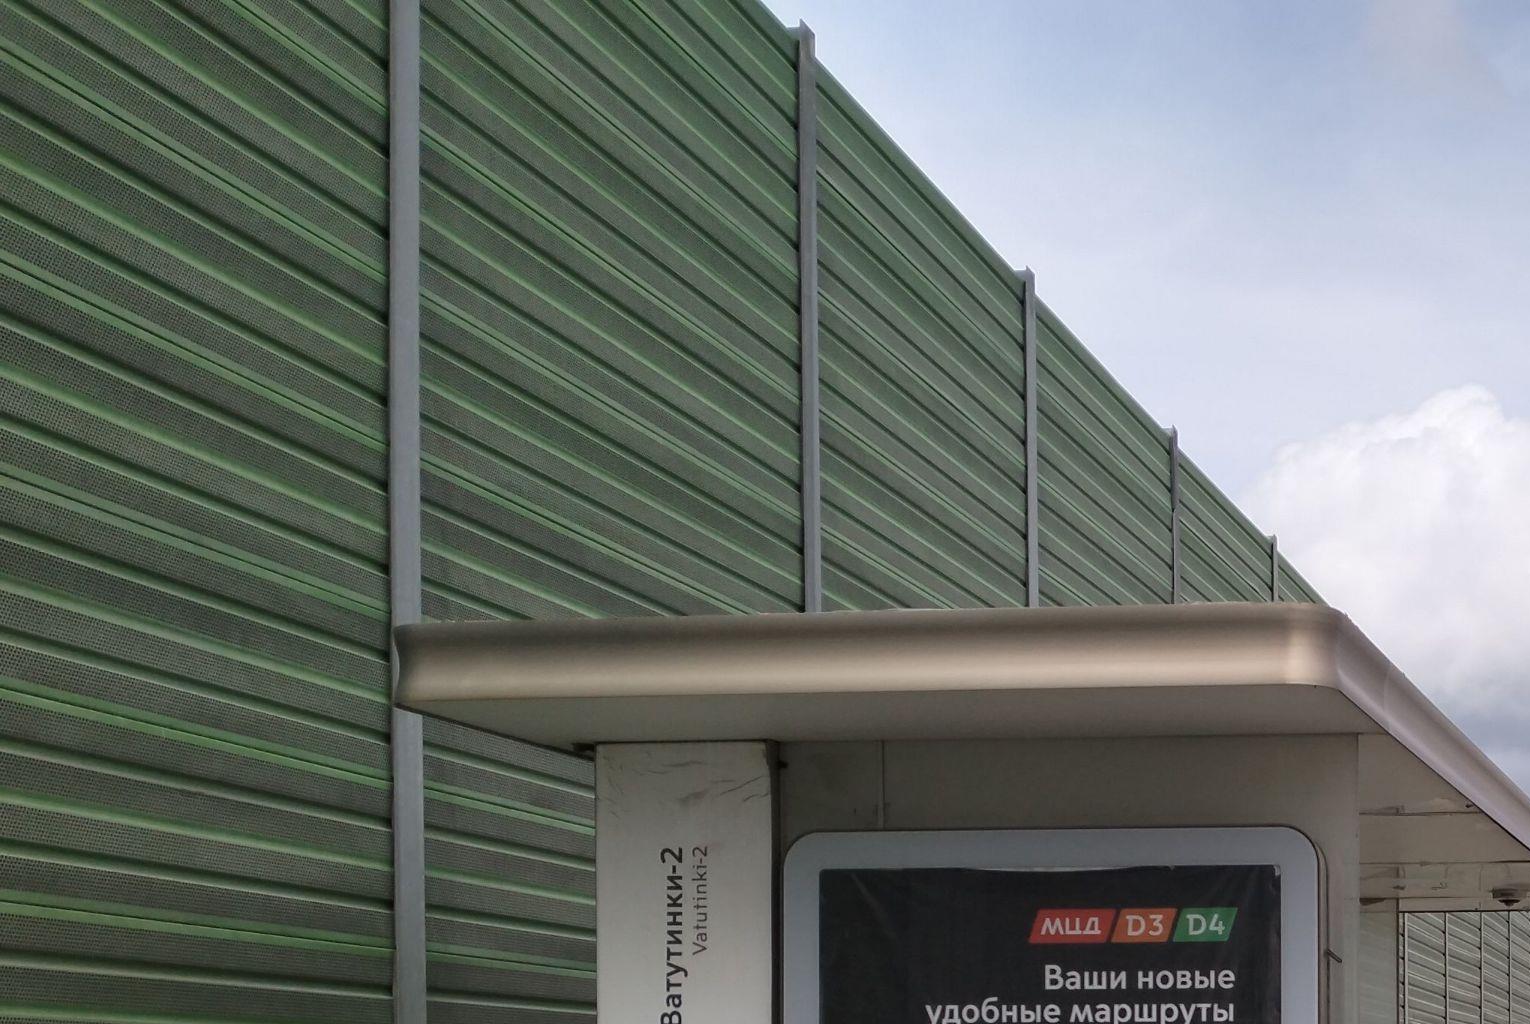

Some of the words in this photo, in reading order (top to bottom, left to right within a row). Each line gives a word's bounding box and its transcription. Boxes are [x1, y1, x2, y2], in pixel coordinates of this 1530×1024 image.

[692, 846, 708, 955] Vatutinki-2
[1040, 917, 1102, 936] МЦД
[1125, 914, 1164, 937] D3
[1186, 913, 1226, 936] D4
[1044, 964, 1127, 990] Ваши
[1137, 968, 1236, 990] новые
